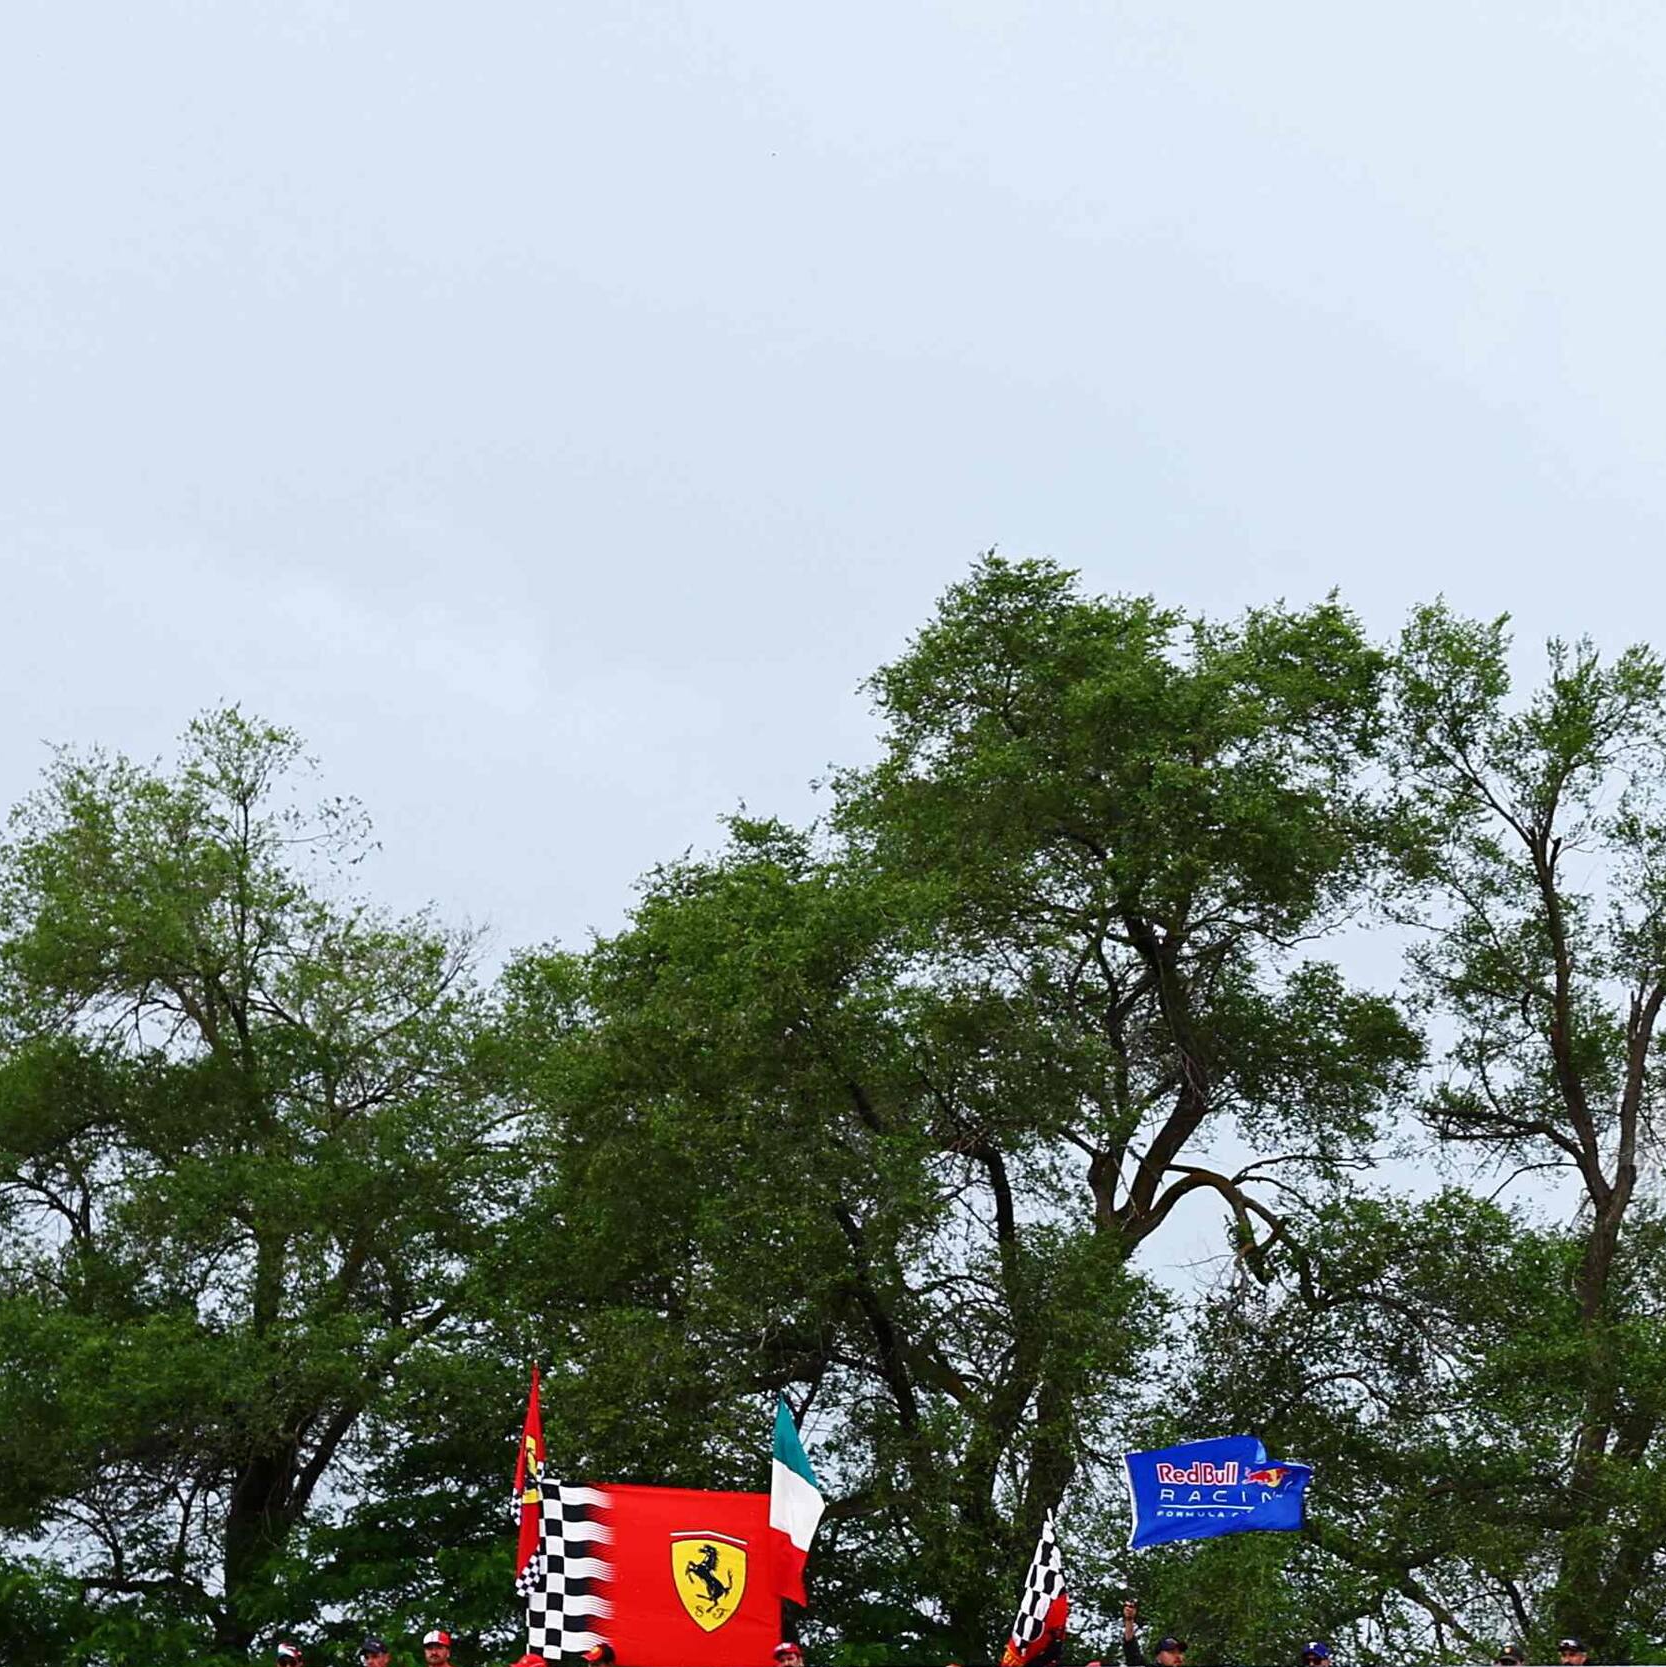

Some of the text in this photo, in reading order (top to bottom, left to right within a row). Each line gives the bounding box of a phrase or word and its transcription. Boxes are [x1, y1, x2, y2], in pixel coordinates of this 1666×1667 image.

[1156, 1462, 1239, 1485] Red Bull
[1160, 1489, 1274, 1503] RACIN
[1156, 1510, 1225, 1518] FORMULA
